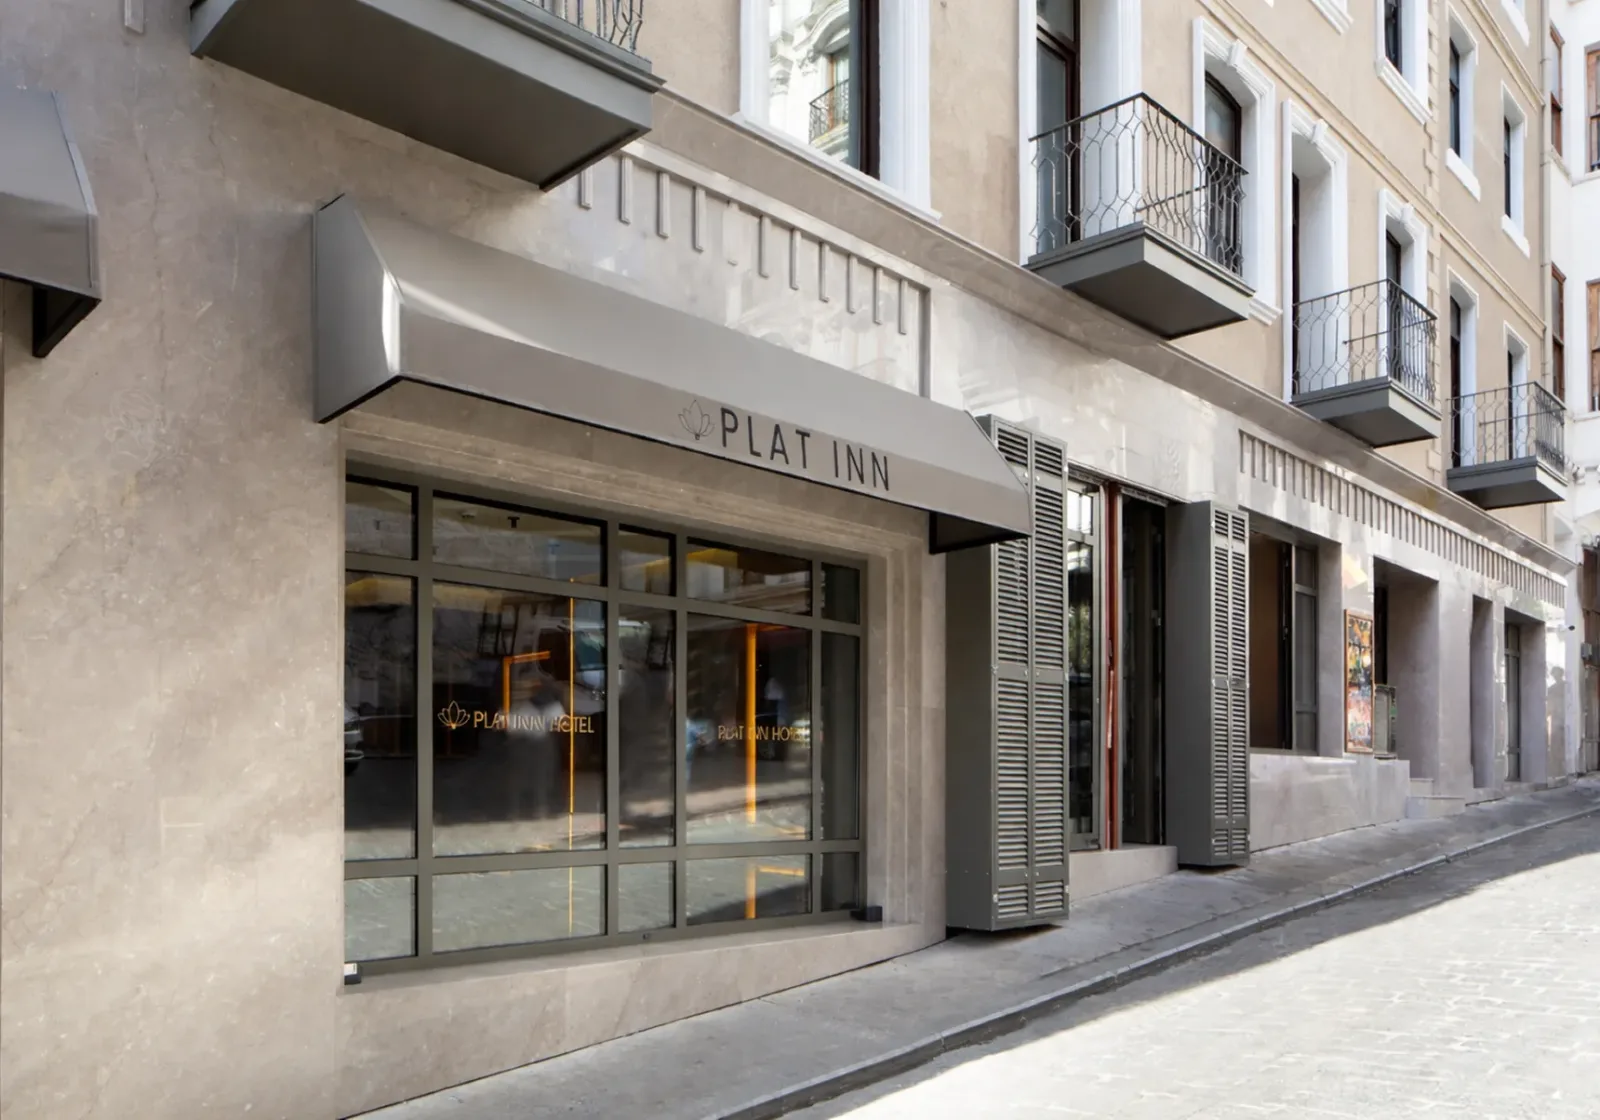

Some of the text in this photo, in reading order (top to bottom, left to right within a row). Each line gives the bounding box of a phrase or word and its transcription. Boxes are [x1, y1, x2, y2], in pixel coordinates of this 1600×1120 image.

[720, 407, 890, 491] PLAT INN
[550, 714, 595, 734] HOTEL
